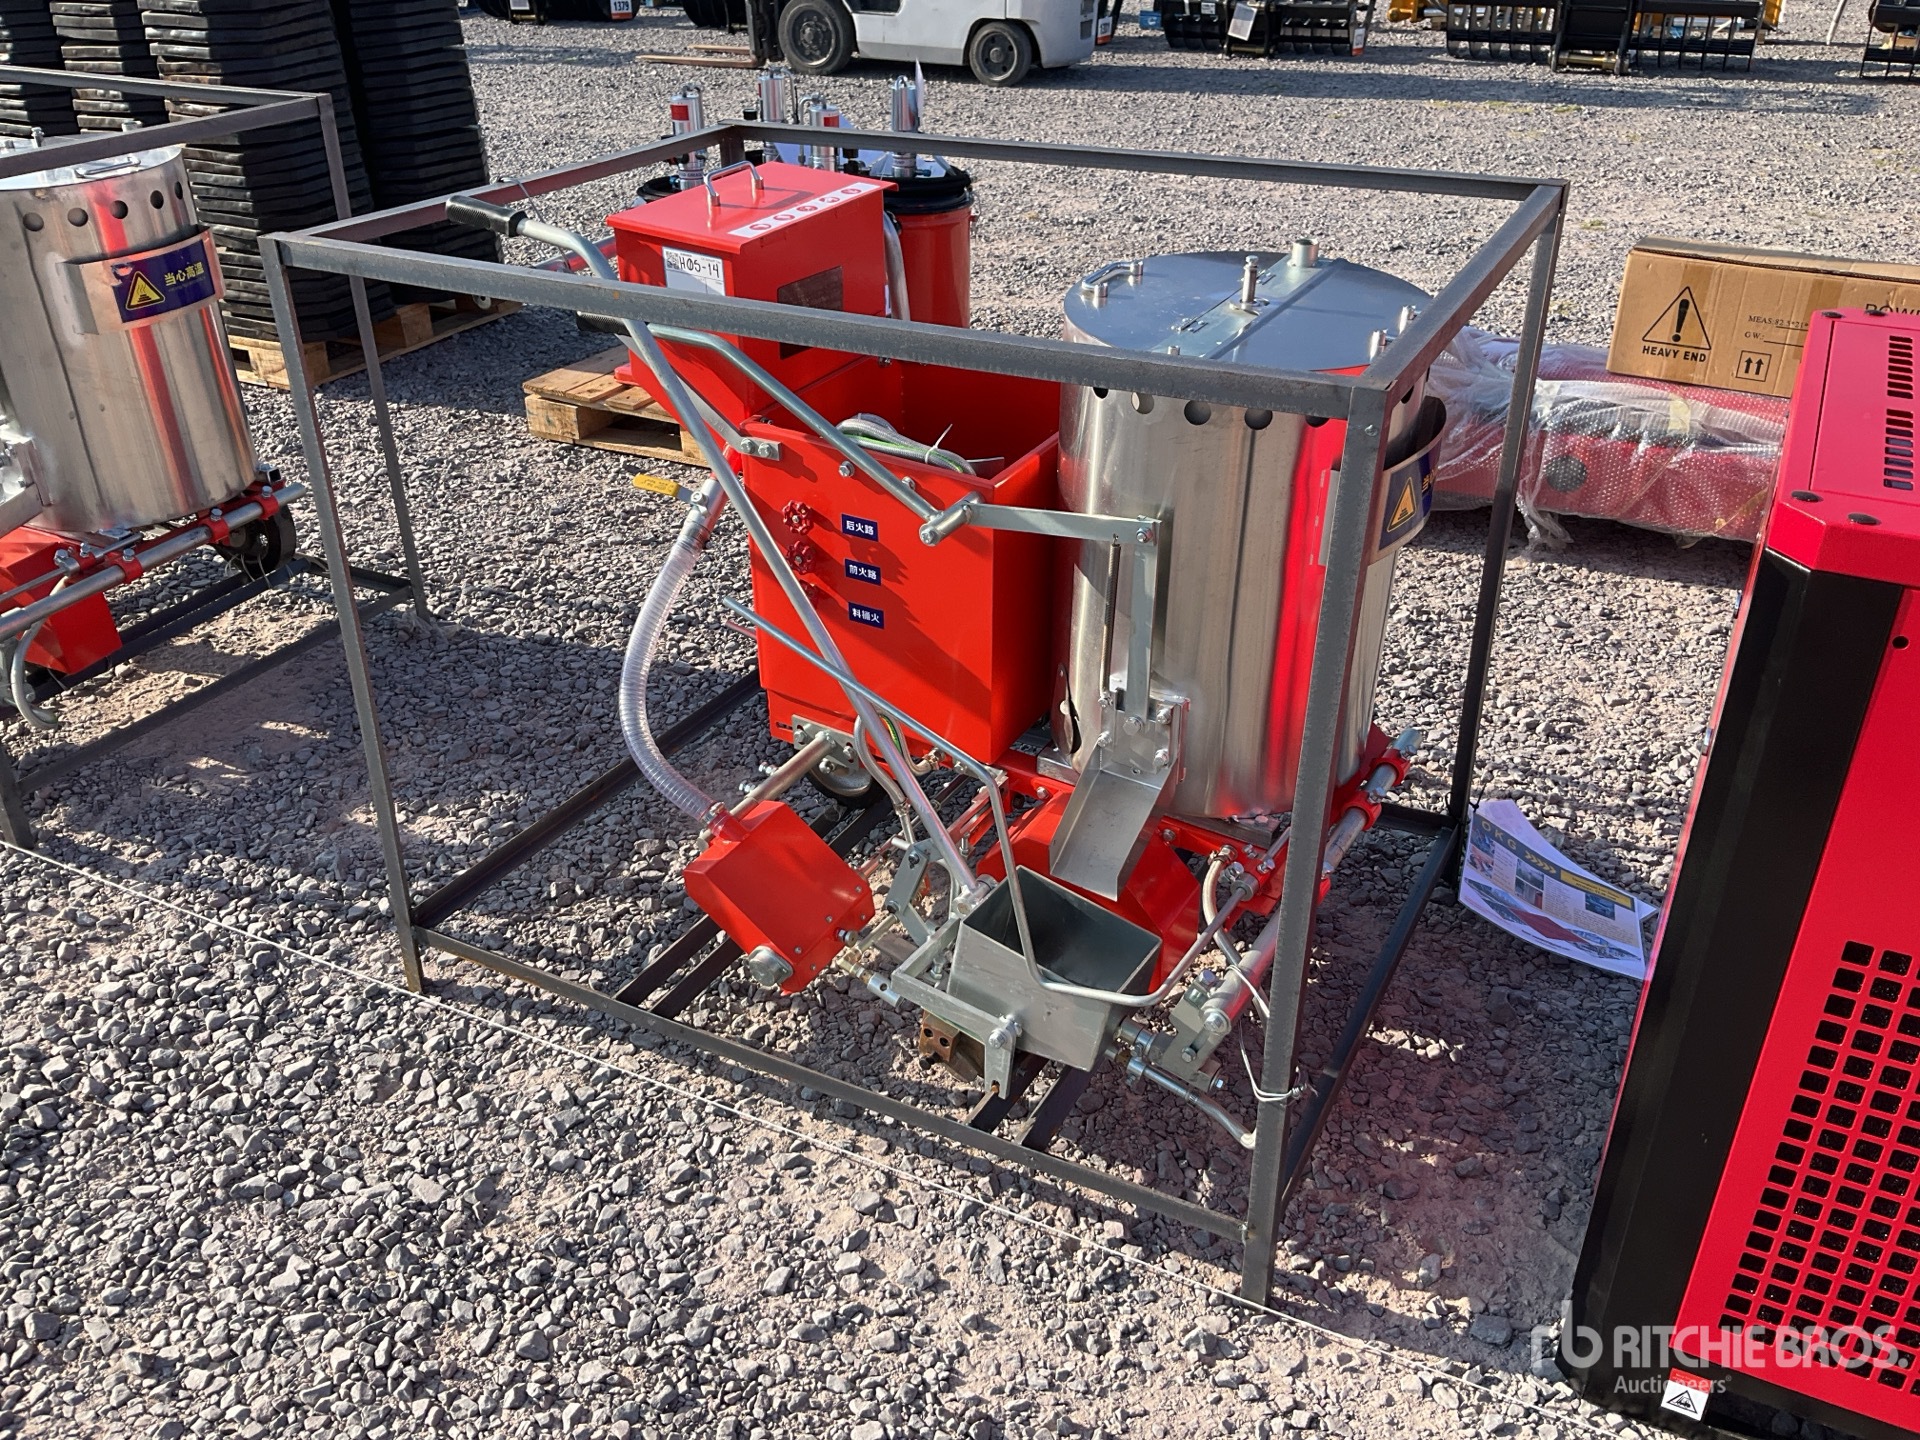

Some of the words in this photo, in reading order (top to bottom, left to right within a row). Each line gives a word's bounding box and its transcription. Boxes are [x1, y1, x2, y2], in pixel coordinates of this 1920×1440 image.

[613, 1, 629, 11] 1379
[164, 261, 204, 286] 当心高温
[1642, 345, 1679, 358] HEAVY
[1683, 350, 1706, 362] END
[849, 564, 877, 580] 前火路
[852, 608, 880, 623] 料桶火
